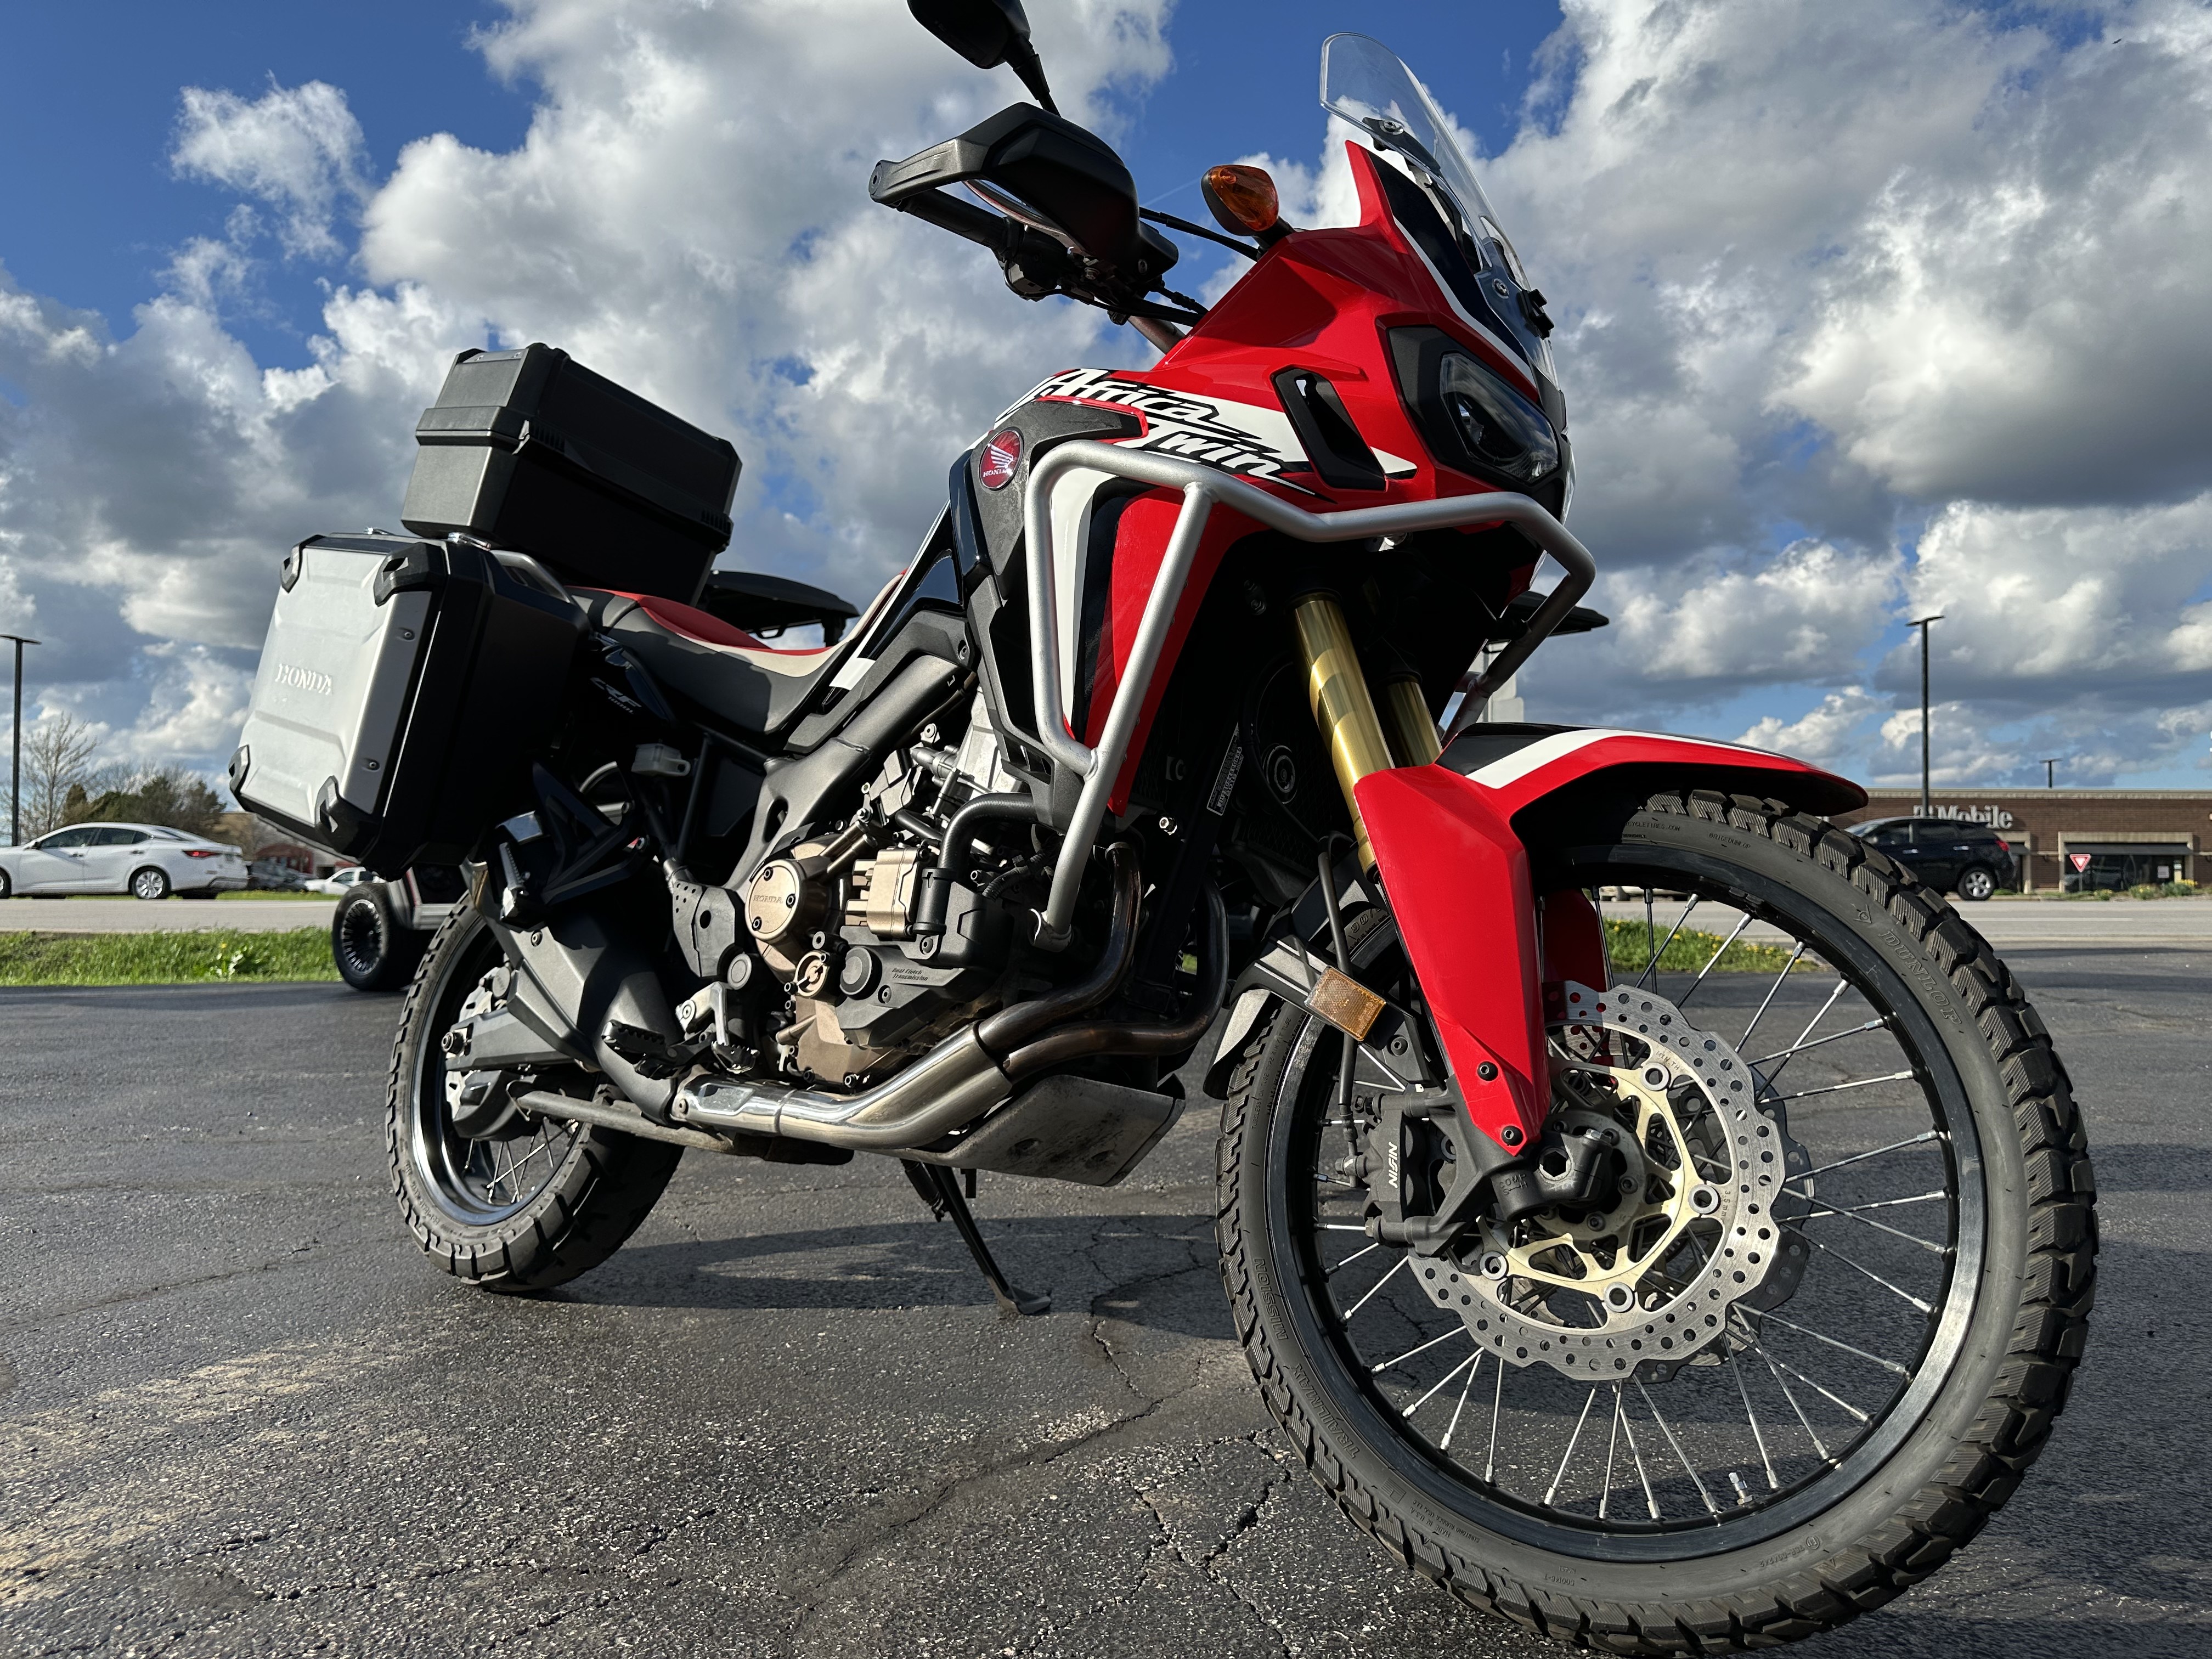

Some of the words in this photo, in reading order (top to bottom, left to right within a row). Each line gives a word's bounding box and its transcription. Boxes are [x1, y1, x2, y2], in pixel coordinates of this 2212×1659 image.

[1036, 367, 1244, 436] Africa
[982, 467, 1009, 477] HOND
[1120, 415, 1316, 495] Twin
[274, 663, 334, 696] HONDA
[589, 677, 642, 708] CRF
[1622, 821, 1681, 832] CYCLETIRES.COM
[752, 894, 783, 904] HONDA
[1878, 930, 1962, 1025] DUNLOP
[1387, 1141, 1398, 1189] NISSIN
[1499, 1173, 1527, 1189] COMP
[1254, 1258, 1289, 1341] MISSION
[1291, 1362, 1360, 1459] TRAILMAX
